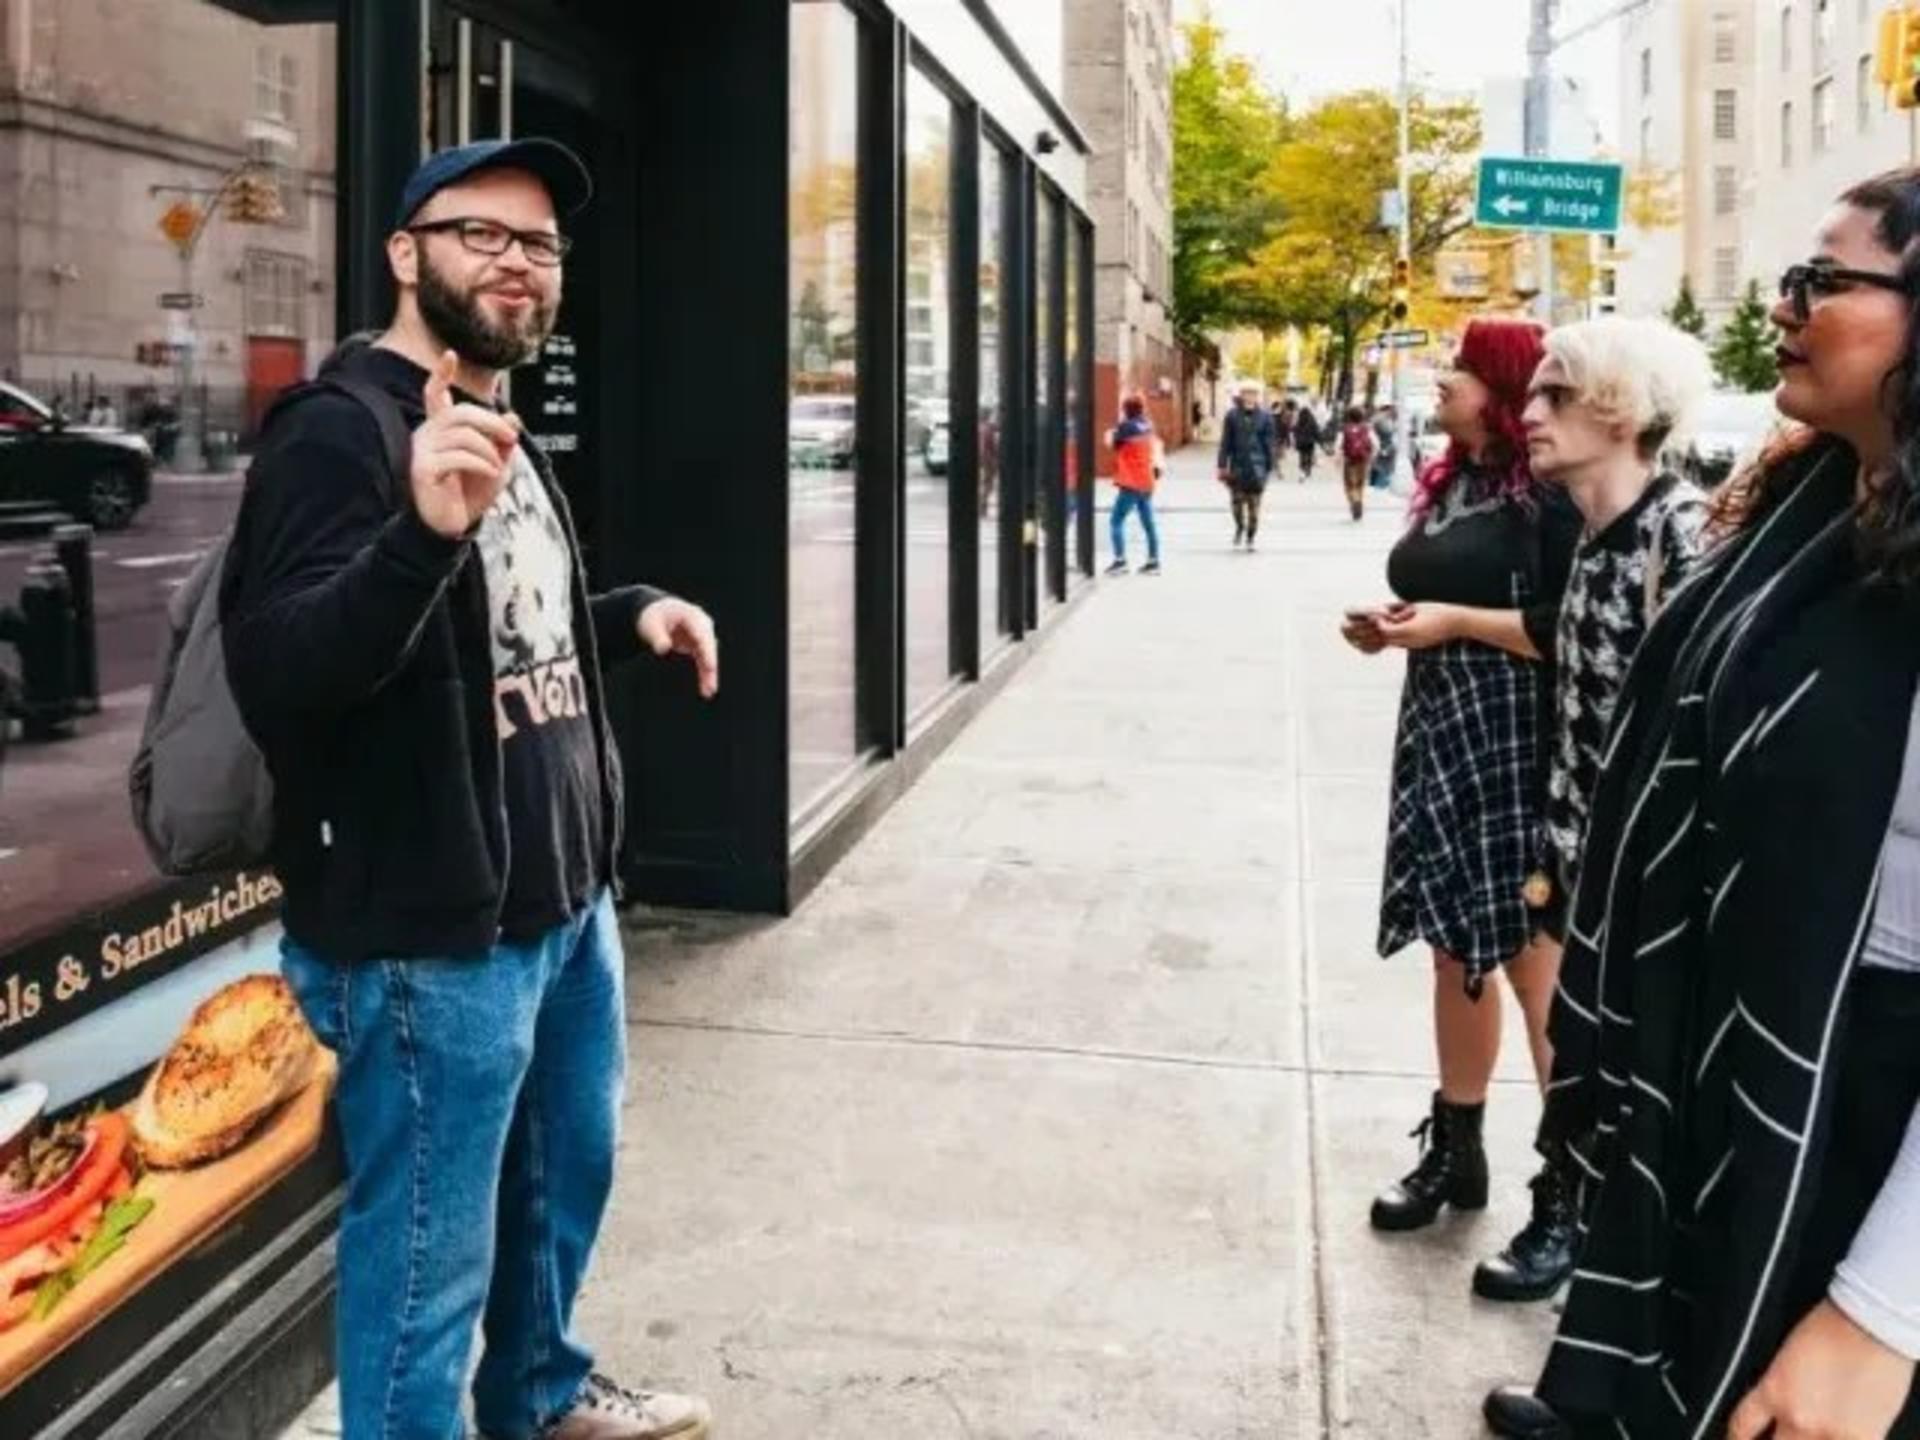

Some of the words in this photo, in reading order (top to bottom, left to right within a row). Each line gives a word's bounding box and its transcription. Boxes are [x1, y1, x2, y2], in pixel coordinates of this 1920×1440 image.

[1495, 168, 1605, 195] Williamsburg
[1543, 197, 1600, 223] Bridge
[53, 955, 91, 1000] &
[100, 872, 284, 980] Sandwiches
